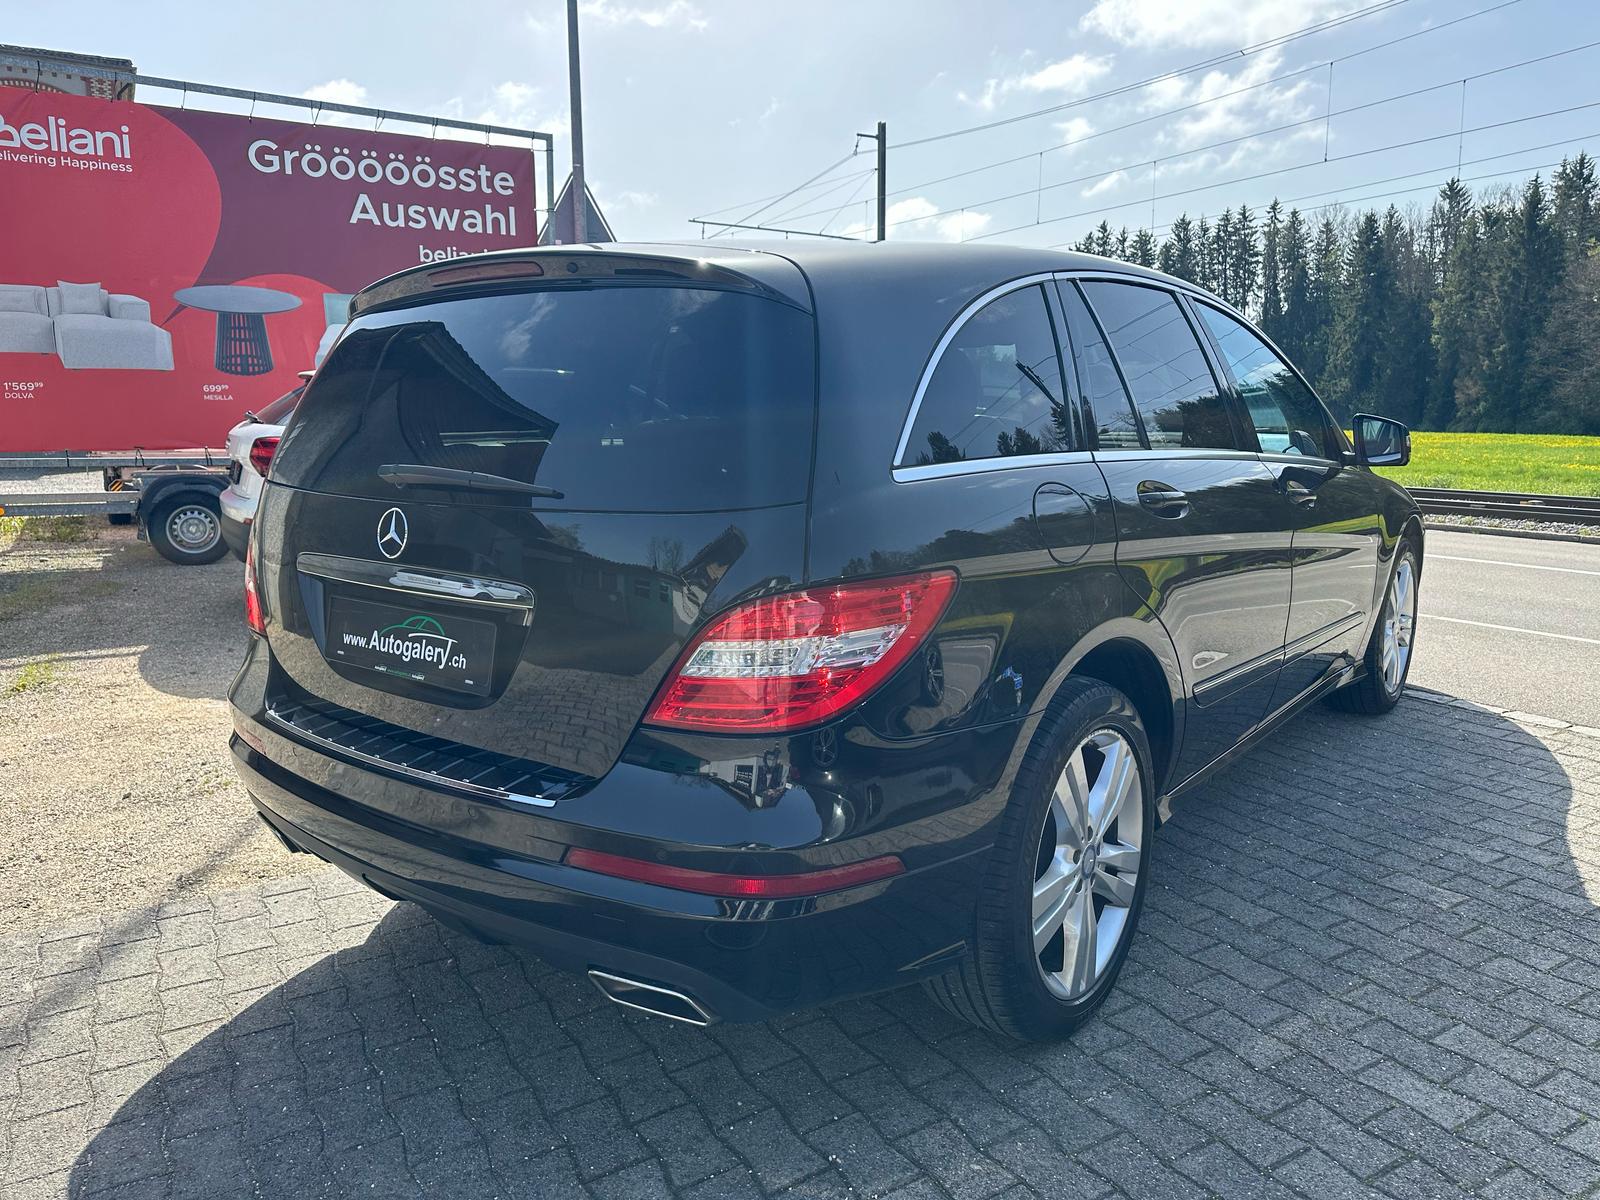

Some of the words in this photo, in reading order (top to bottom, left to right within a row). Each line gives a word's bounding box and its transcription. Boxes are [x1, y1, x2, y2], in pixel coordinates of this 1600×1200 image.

[61, 156, 133, 172] Happiness
[248, 139, 515, 195] Grööööösste
[350, 193, 517, 236] Auswahl
[419, 245, 488, 262] beli
[343, 630, 467, 670] www.Autogalery.ch
